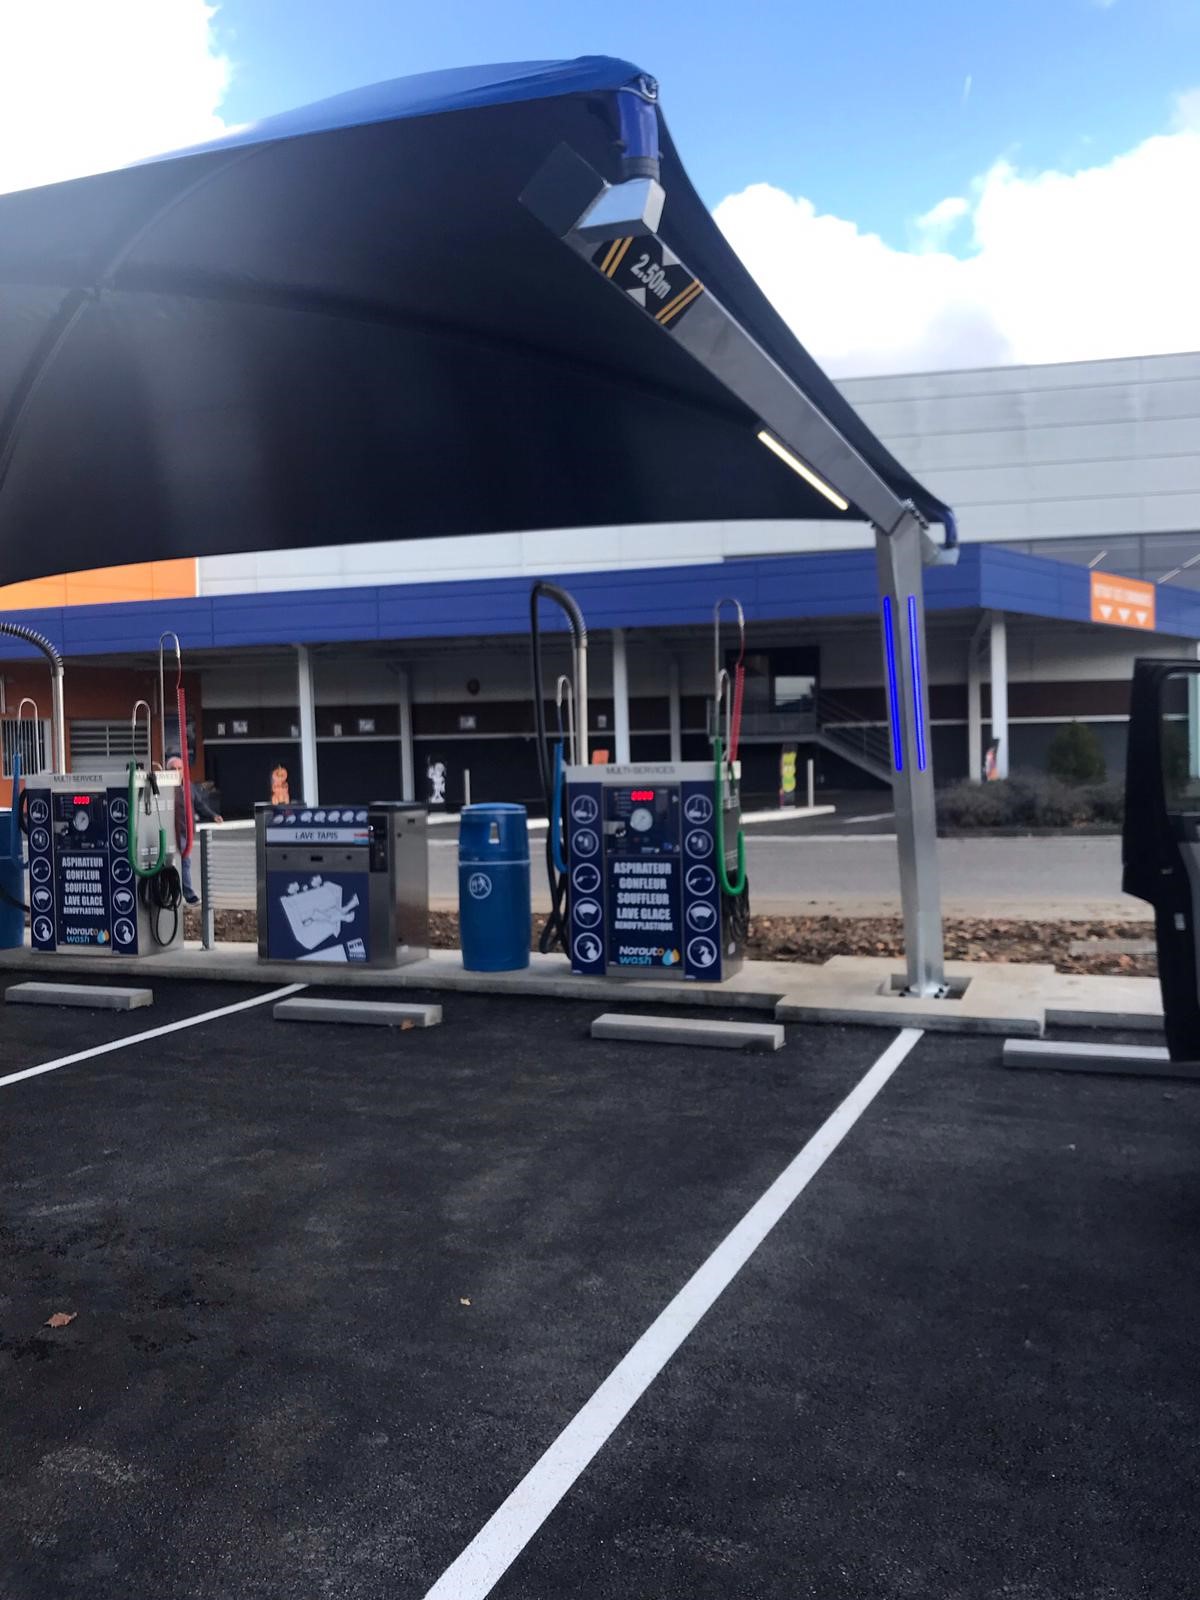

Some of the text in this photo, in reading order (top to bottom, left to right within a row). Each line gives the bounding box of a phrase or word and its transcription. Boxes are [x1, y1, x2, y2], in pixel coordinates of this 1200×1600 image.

[630, 254, 671, 299] 2.50m
[295, 831, 338, 840] LAVE TAPIS
[62, 857, 103, 867] ASPIRATEUR
[613, 862, 672, 875] ASPIRATEUR
[66, 870, 100, 880] GONFLEUR
[64, 883, 102, 893] SOUFFLEUR
[619, 877, 667, 890] GONFLEUR
[64, 895, 103, 906] LAVE GLACE
[617, 892, 670, 905] SOUFFLEUR
[616, 907, 671, 920] LAVE GLACE
[66, 927, 98, 935] Norauto
[66, 935, 90, 943] wash
[619, 946, 664, 956] Norauto
[619, 956, 652, 965] wash
